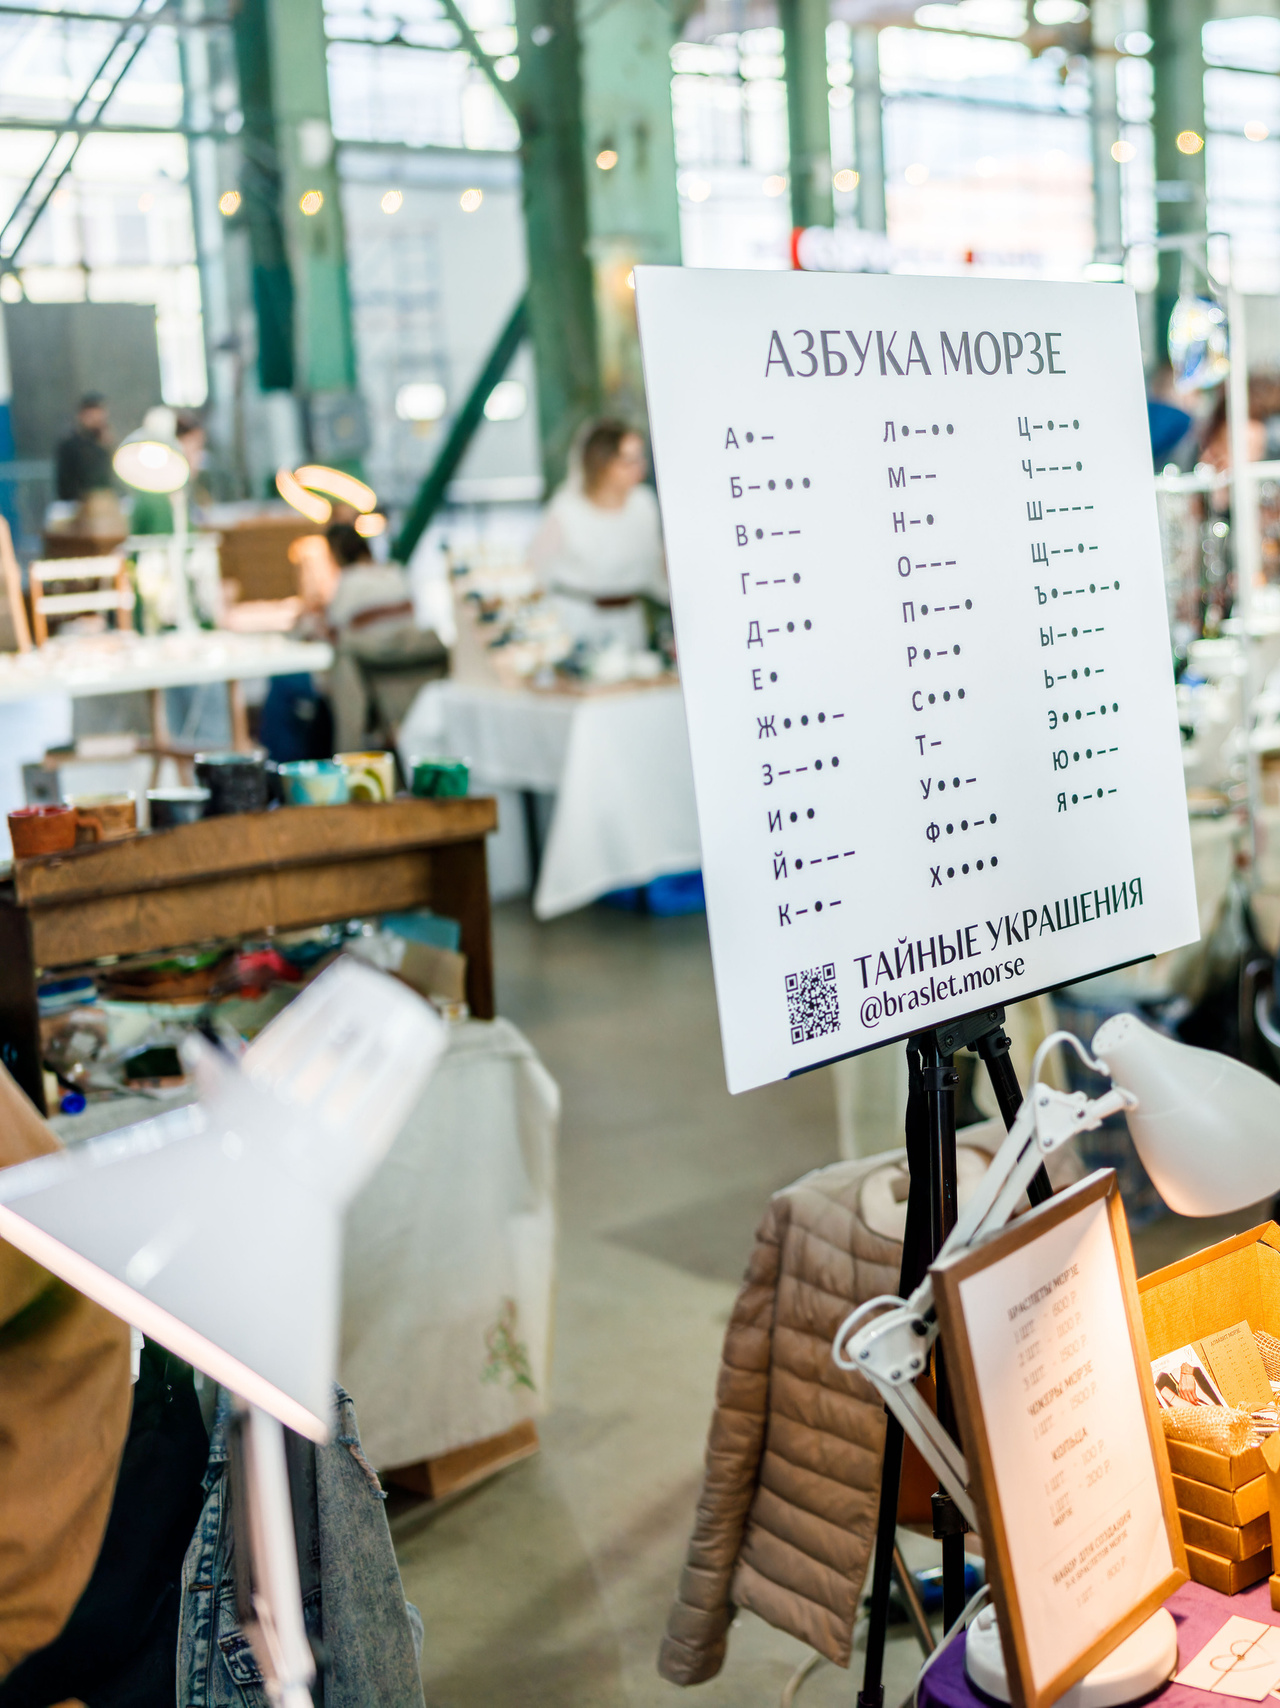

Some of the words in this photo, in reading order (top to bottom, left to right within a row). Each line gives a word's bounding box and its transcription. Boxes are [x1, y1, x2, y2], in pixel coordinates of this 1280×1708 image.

[765, 329, 933, 378] АЗБУКА
[939, 330, 1067, 376] МОРЗЕ
[853, 923, 983, 990] ТАЙНЫЕ
[985, 876, 1144, 951] УКРАШЕНИЯ
[860, 956, 1026, 1029] @braslet.morse
